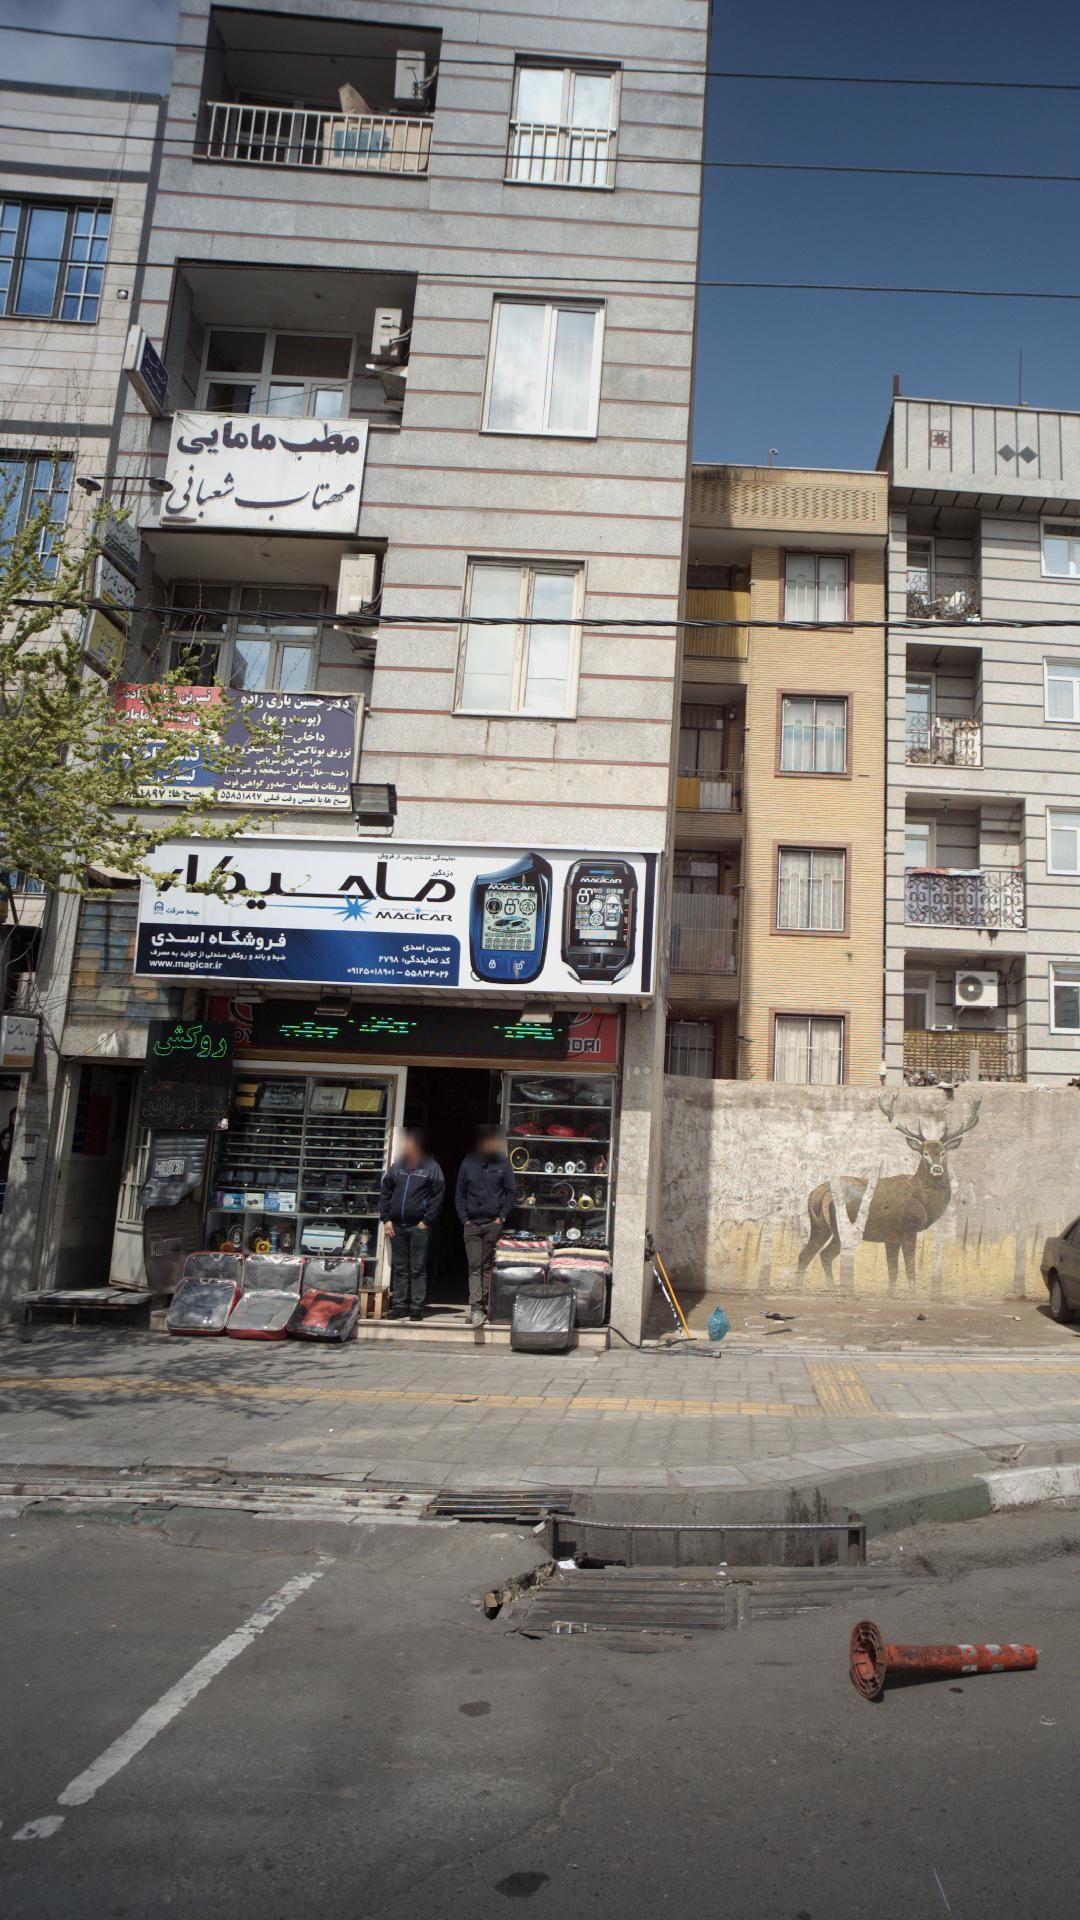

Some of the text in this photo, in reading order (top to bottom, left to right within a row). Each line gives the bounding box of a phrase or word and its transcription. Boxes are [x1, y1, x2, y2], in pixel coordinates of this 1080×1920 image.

[177, 420, 360, 461] مطب مامایی
[165, 464, 355, 521] مهتاب شعبانی
[241, 694, 350, 711] دکر حسین یاری زاده
[327, 747, 352, 758] تزریق
[255, 756, 322, 767] جراحی های سرپایی
[223, 778, 239, 788] فوت
[240, 778, 265, 789] گواهی
[321, 783, 349, 793] تزریقات
[220, 790, 262, 800] ۵۵۸۵۱۸۹۷
[263, 794, 280, 803] قبلی
[281, 795, 296, 804] وقت
[297, 796, 315, 805] تعیین
[334, 797, 348, 806] صبح
[431, 869, 454, 877] دزدگیر
[186, 908, 199, 916] بیمه
[375, 911, 453, 922] MAGICAR
[151, 930, 287, 950] فروشگاه اسدی
[402, 943, 451, 952] محسن اسدی
[150, 949, 170, 957] مصرف
[180, 950, 197, 958] تولید
[205, 951, 227, 959] صندلی
[228, 952, 248, 960] روکش
[272, 953, 286, 961] ضبط
[378, 955, 400, 963] ۲۷۹۸
[149, 960, 223, 970] www.magicar.ir
[347, 968, 395, 976] ۰۹۱۲۵۰۱۸۹۰۱
[404, 970, 449, 978] ۵۵۸۳۴۰۲۶
[153, 1025, 228, 1058] روکش
[568, 1037, 601, 1054] DAI
